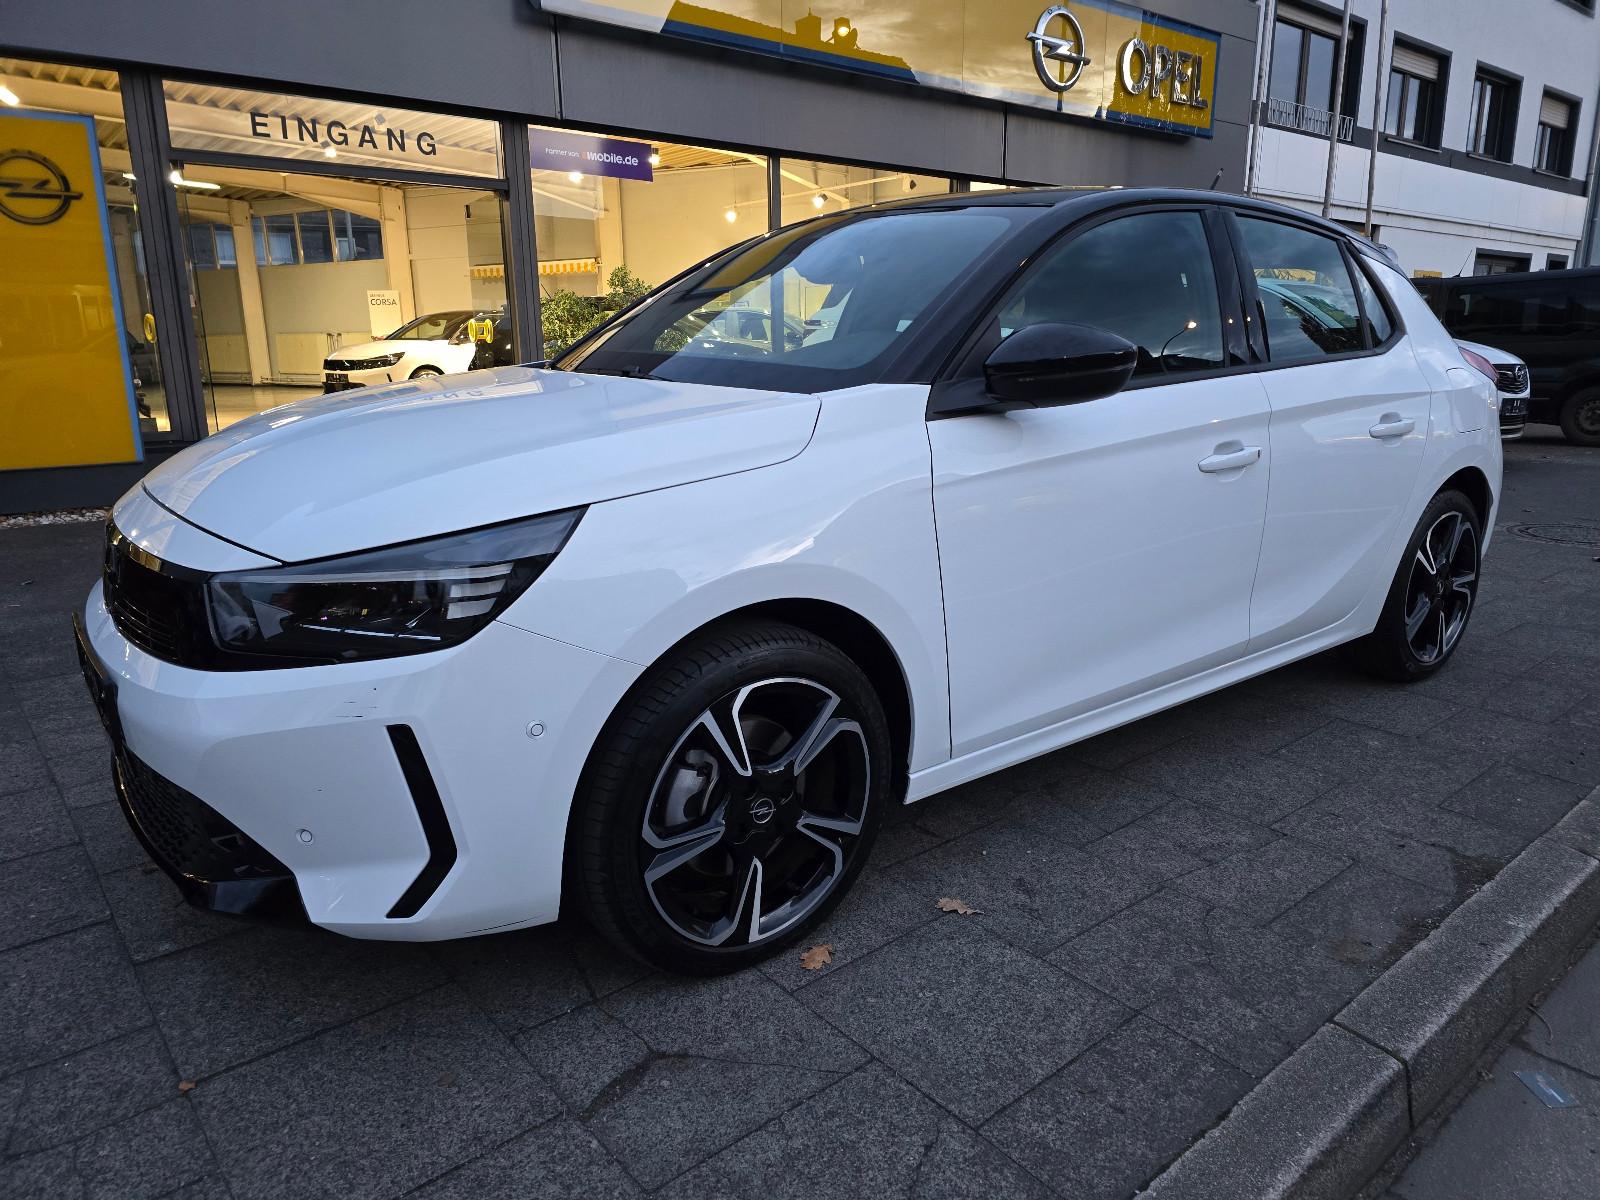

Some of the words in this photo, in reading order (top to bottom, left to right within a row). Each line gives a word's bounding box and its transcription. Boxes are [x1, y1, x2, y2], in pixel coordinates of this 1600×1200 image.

[1121, 37, 1208, 109] OPEL
[250, 111, 437, 156] EINGANG
[370, 298, 398, 306] CORSA
